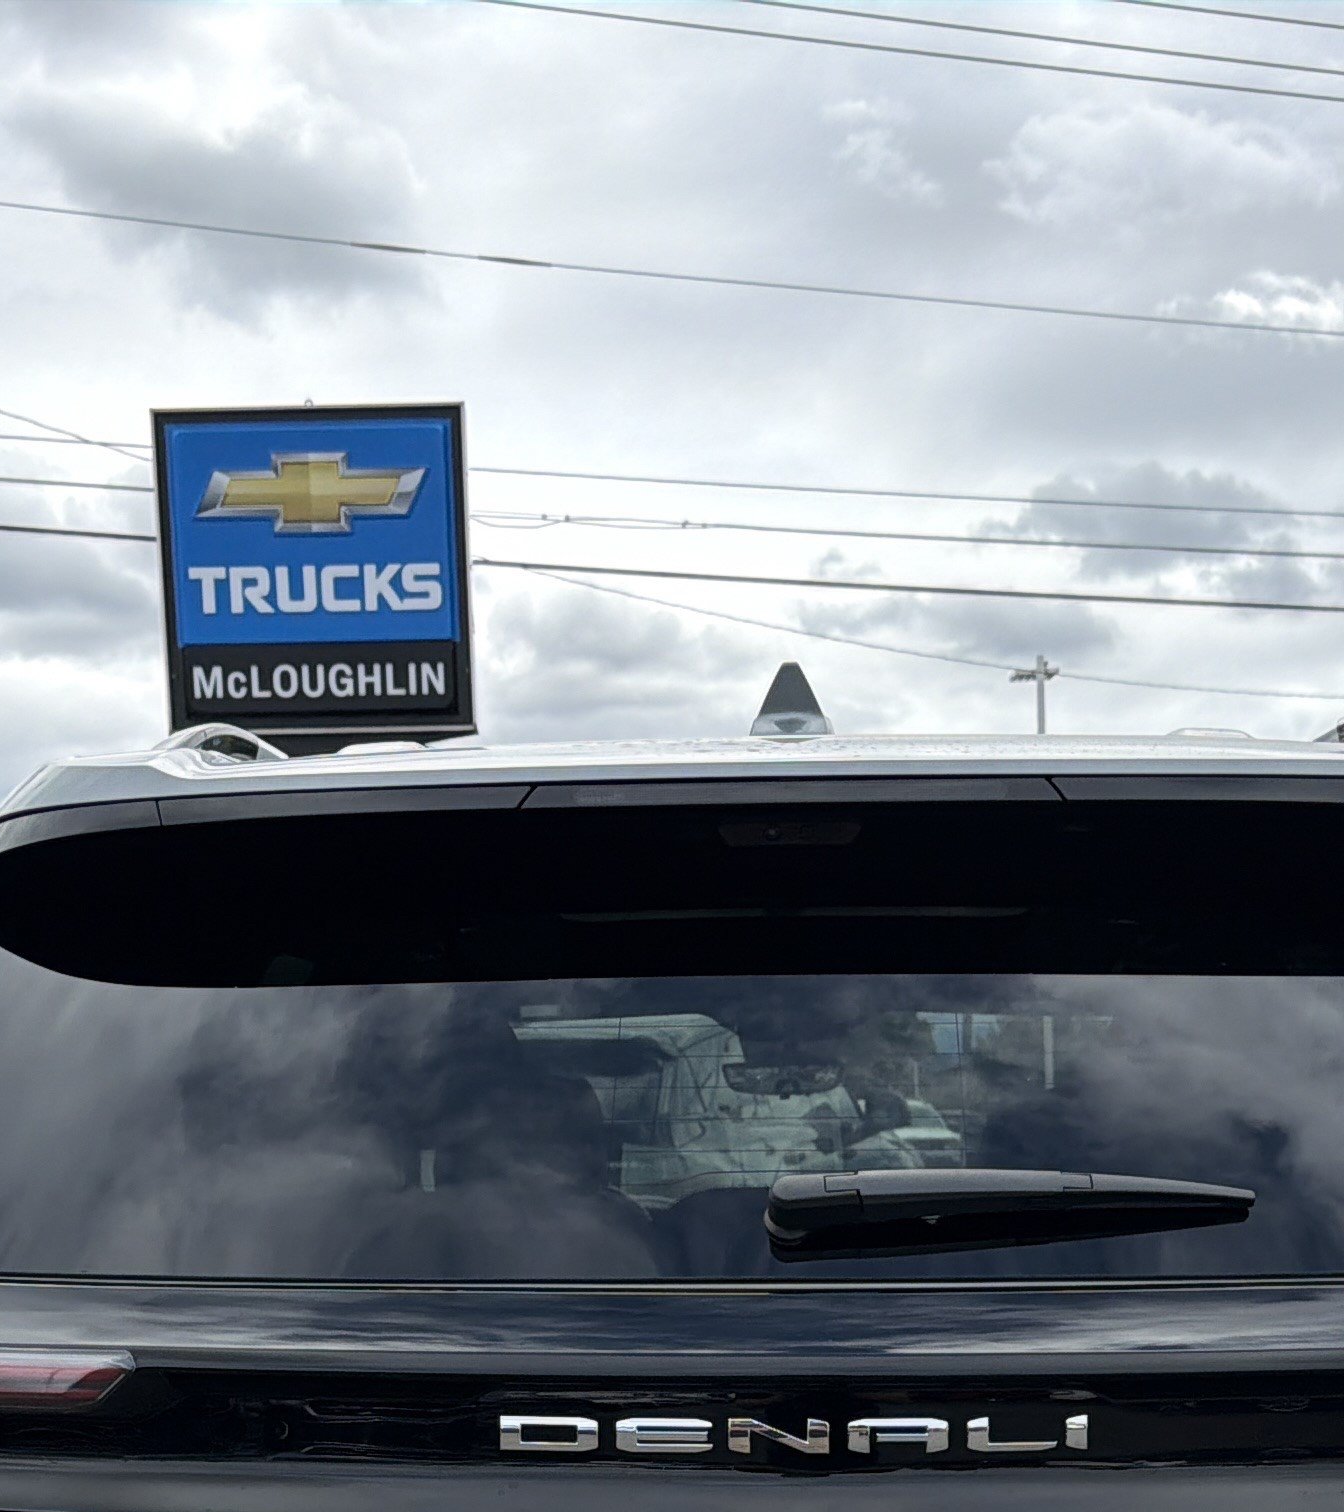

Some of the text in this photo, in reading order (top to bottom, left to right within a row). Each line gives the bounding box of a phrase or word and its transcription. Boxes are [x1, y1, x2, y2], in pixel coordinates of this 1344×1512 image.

[188, 562, 443, 615] TRUCKS
[192, 661, 446, 700] McLOUGHLIN
[499, 1413, 1089, 1454] DENALI
